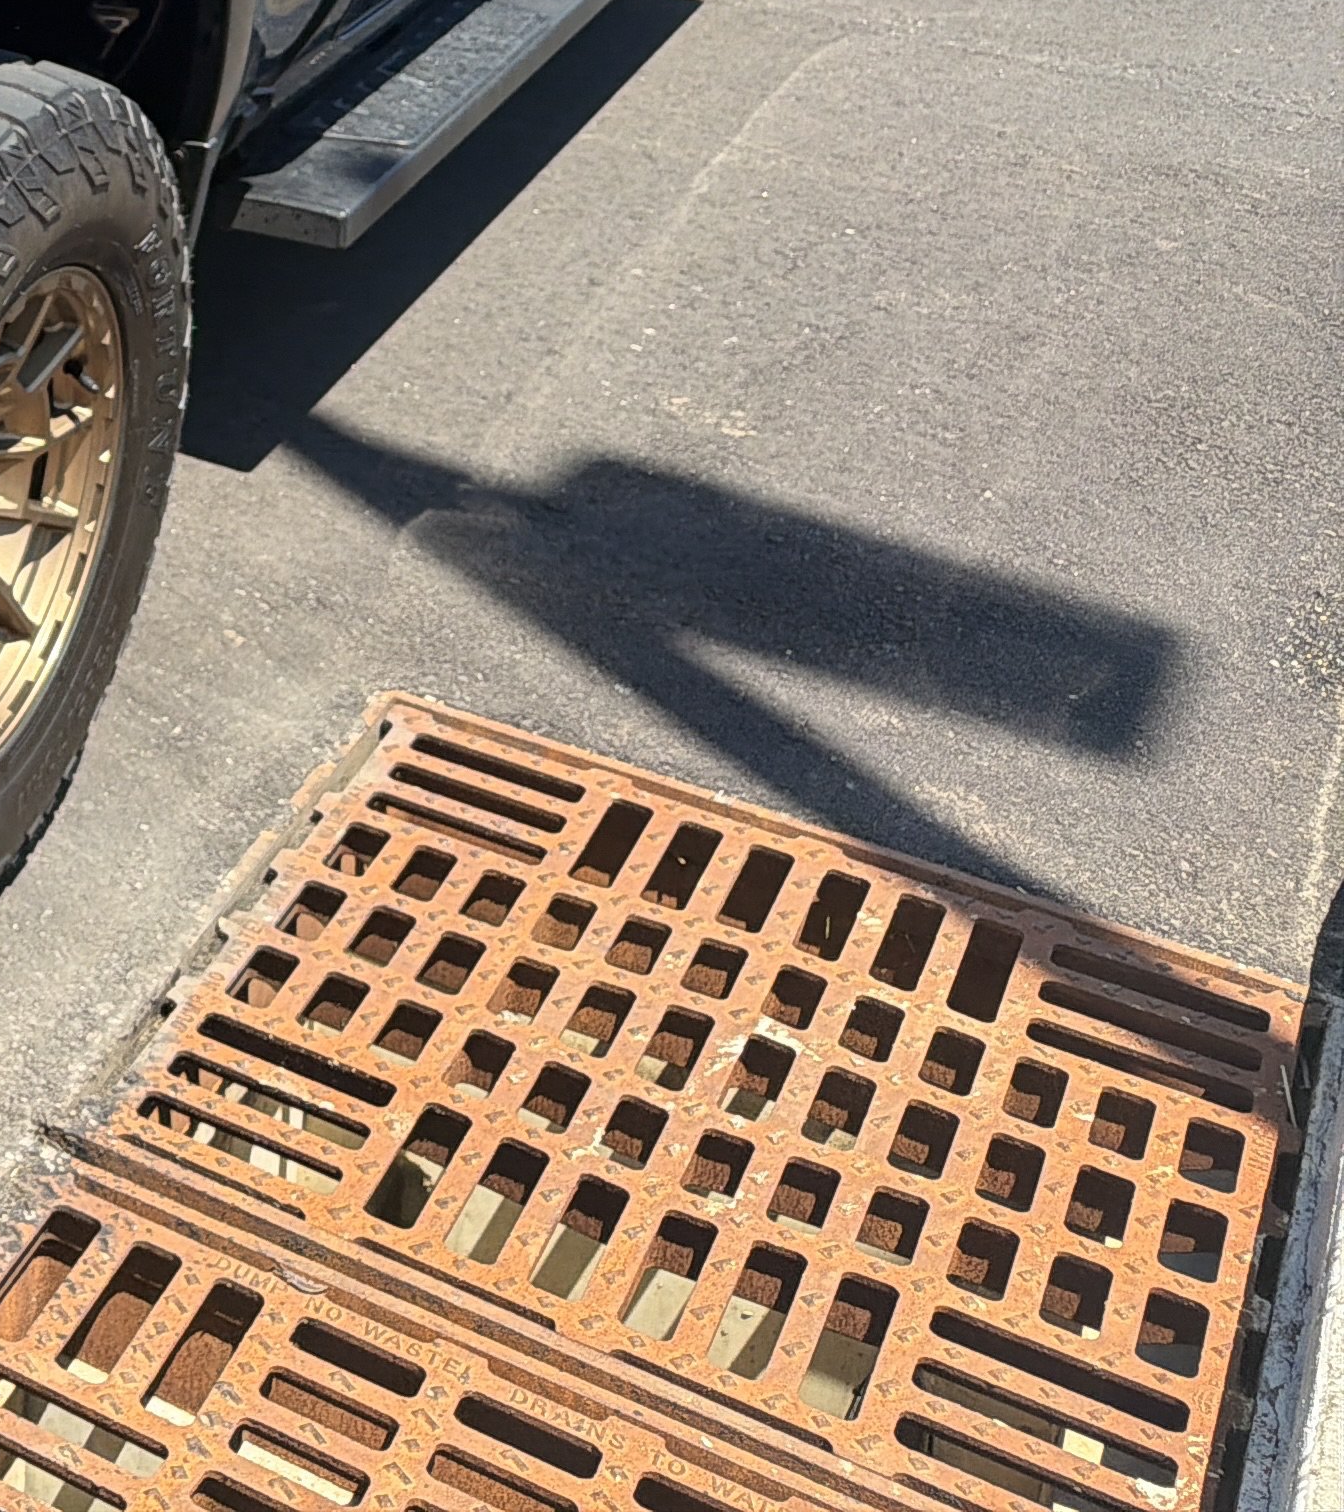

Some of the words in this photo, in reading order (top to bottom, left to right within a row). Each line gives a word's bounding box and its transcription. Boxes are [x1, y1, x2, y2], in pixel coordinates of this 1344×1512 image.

[210, 1256, 289, 1294] DUMP
[303, 1296, 343, 1322] NO
[508, 1386, 626, 1451] DRAINS
[650, 1450, 686, 1476] TO
